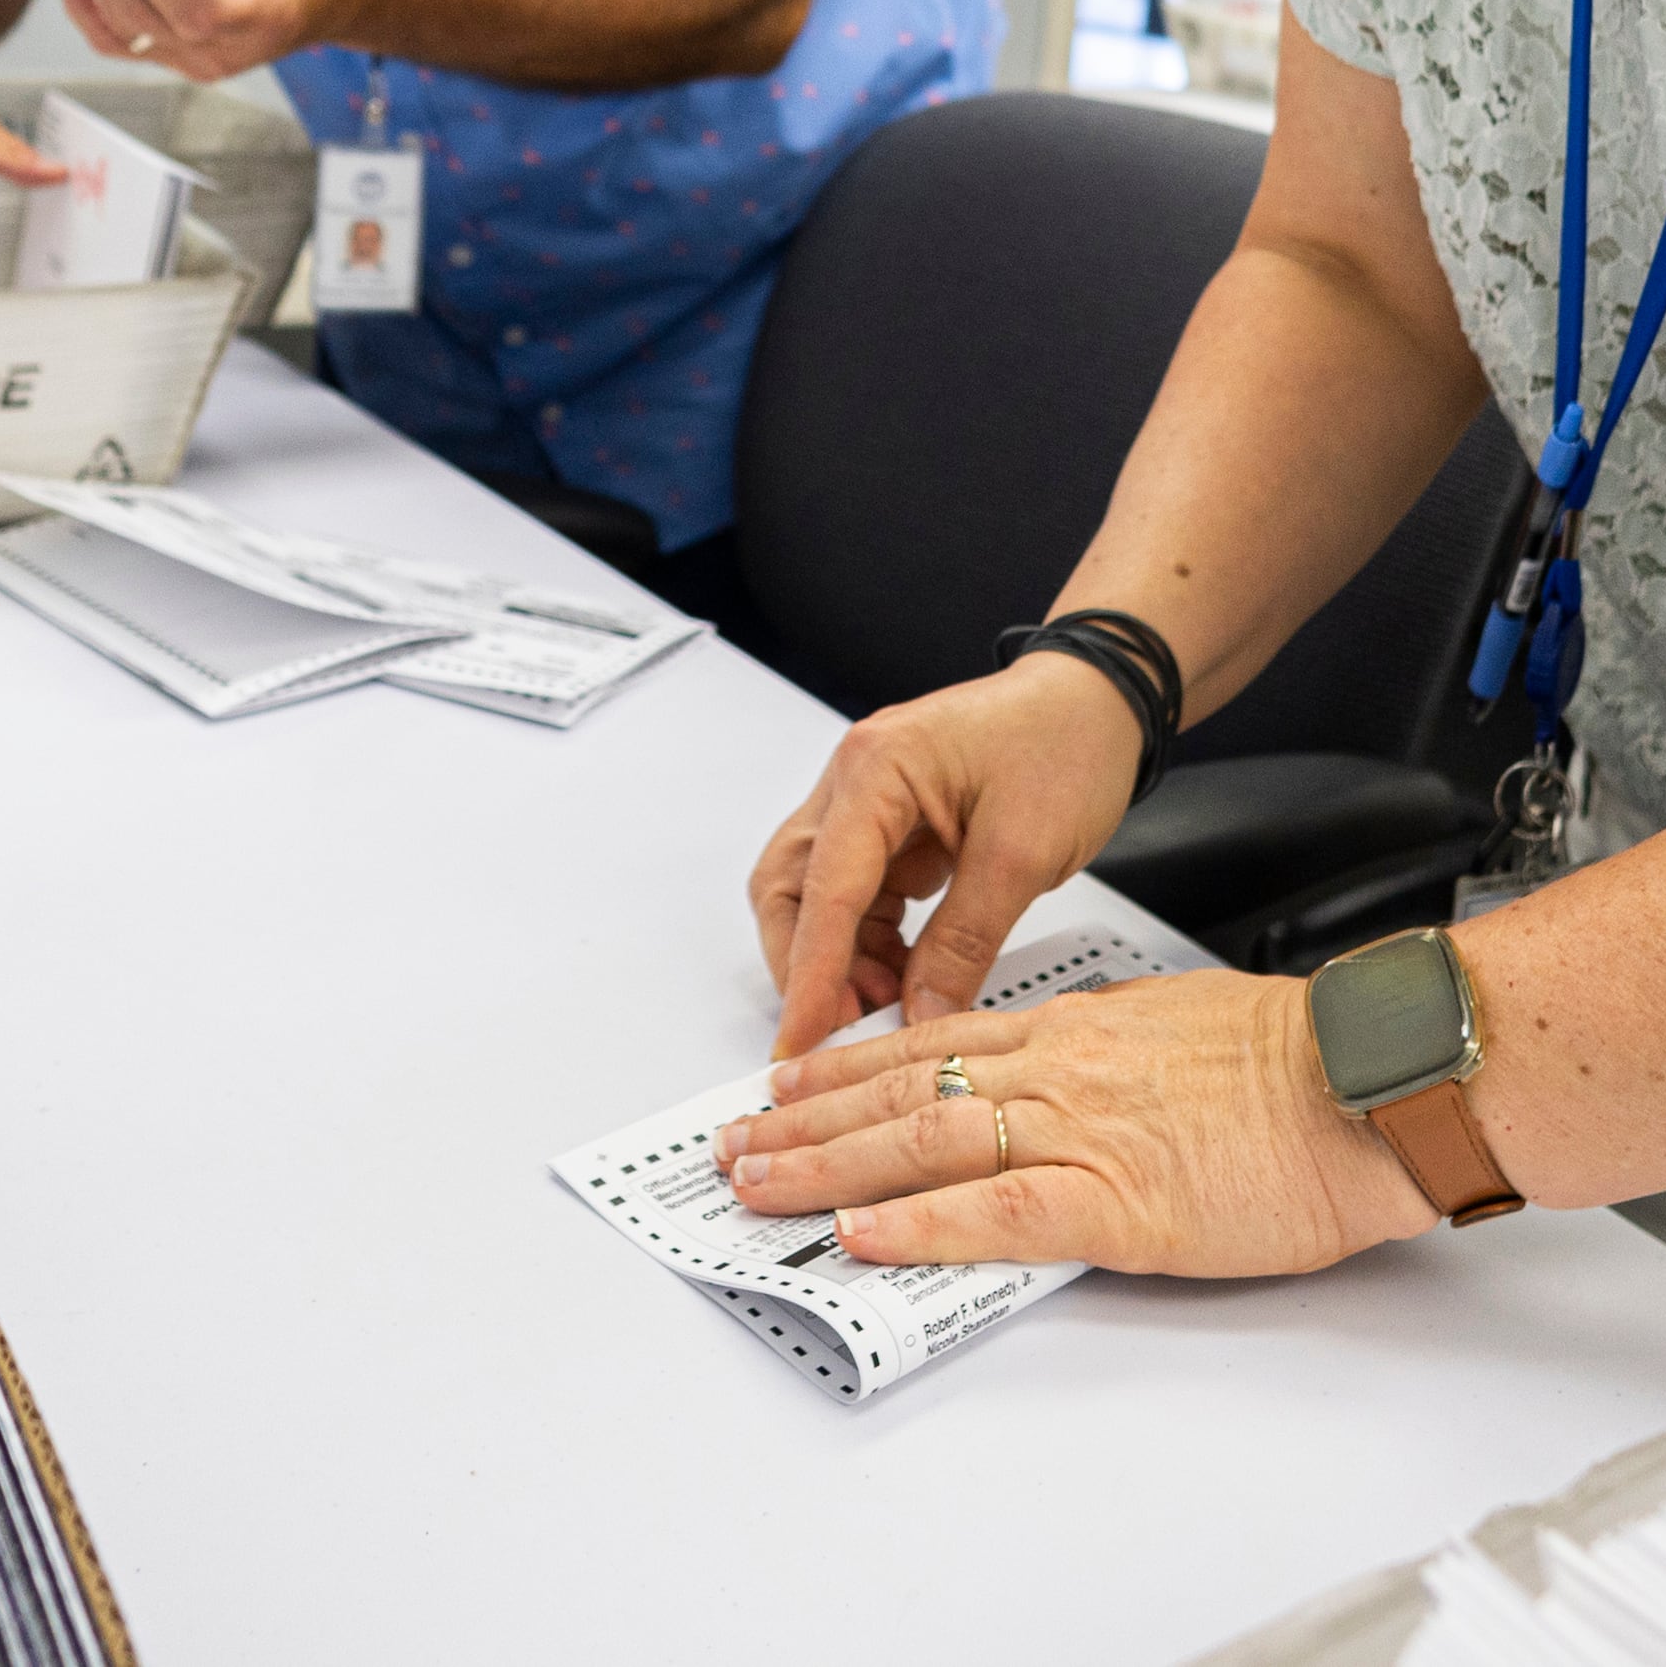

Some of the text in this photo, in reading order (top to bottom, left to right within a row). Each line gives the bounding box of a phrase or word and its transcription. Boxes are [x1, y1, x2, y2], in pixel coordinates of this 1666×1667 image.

[642, 1159, 713, 1194] Official Ballot
[663, 1182, 717, 1211] November
[891, 1276, 918, 1294] Tim
[904, 1264, 977, 1306] Democratic Party
[923, 1270, 1036, 1340] Robert F. Kennedy, Jr.
[925, 1303, 1011, 1359] Nicole Shanahan
